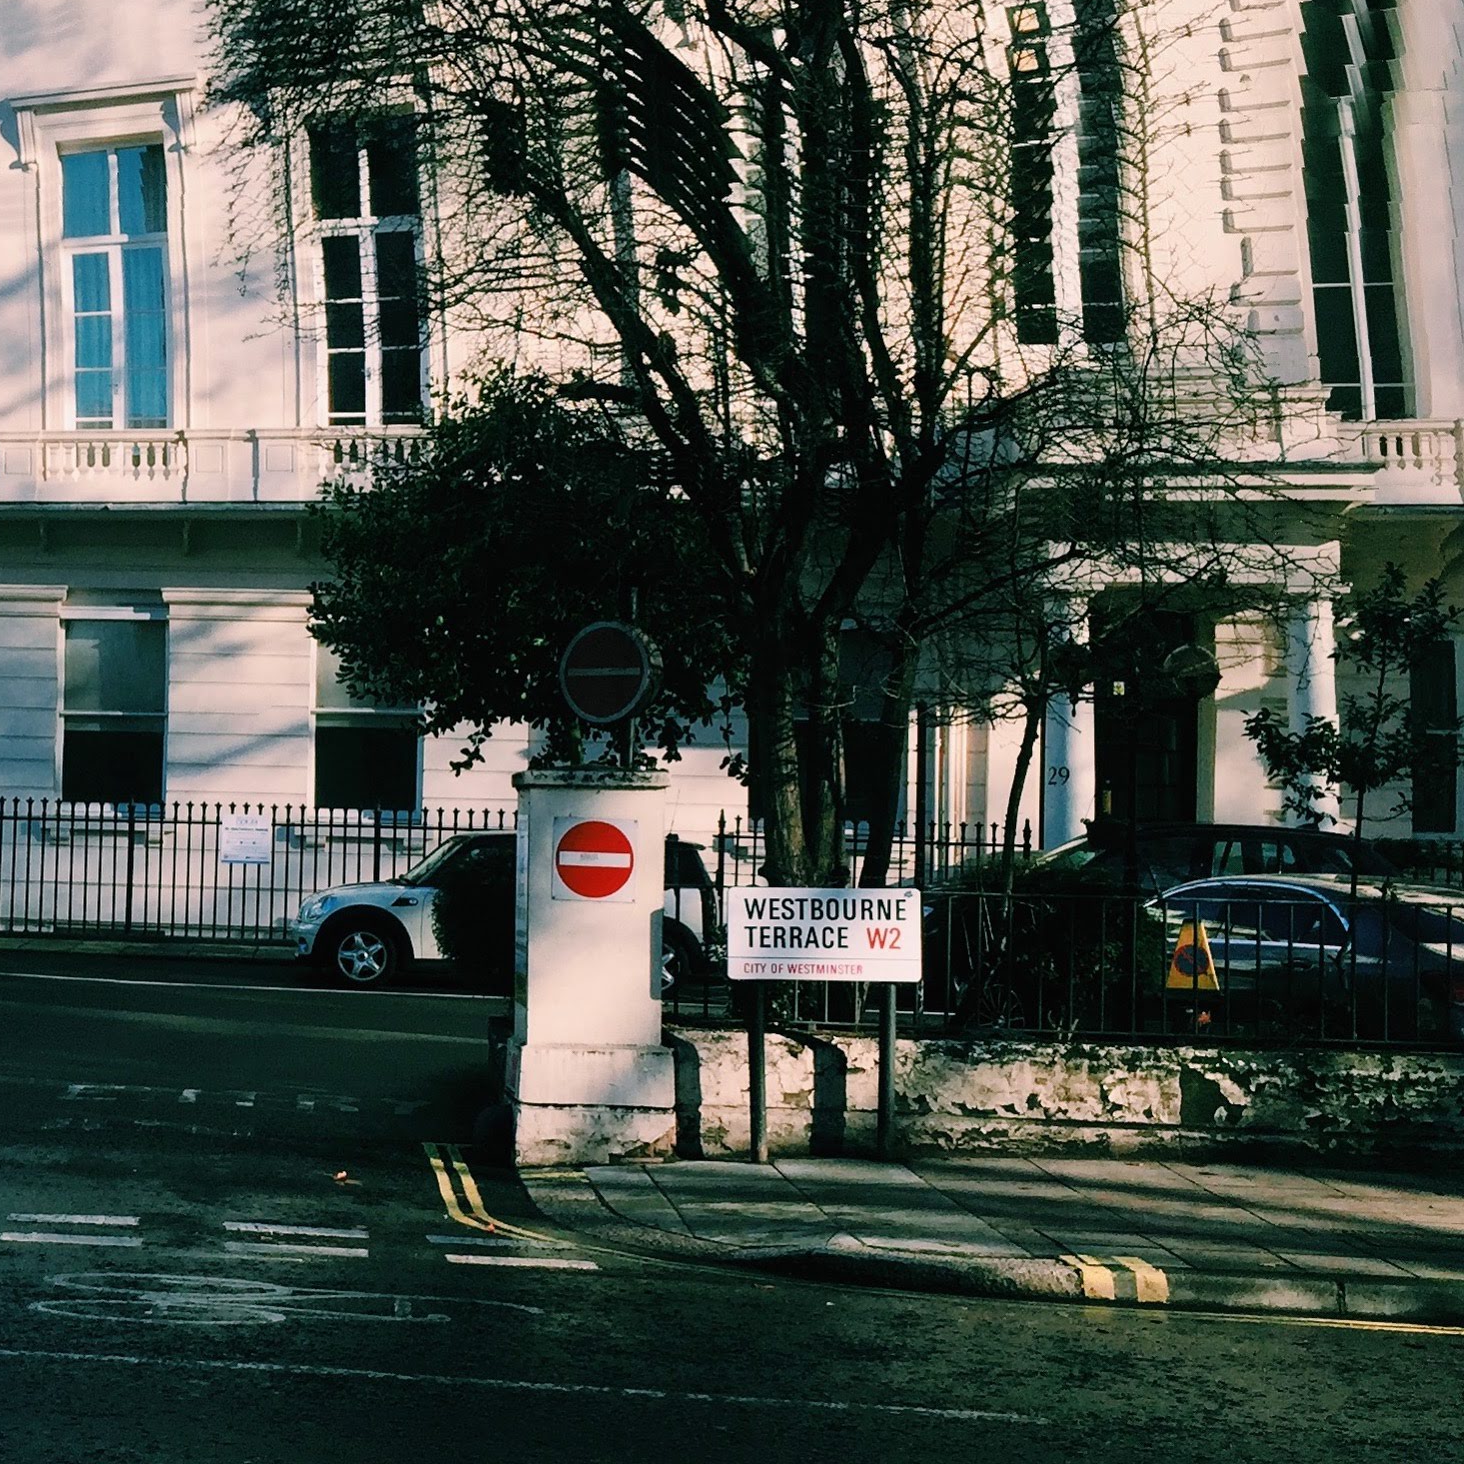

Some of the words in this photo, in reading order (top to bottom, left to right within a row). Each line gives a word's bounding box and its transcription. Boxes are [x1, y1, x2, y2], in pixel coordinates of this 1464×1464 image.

[1047, 766, 1070, 786] 29
[744, 898, 907, 921] WESTBOURNE
[744, 926, 849, 949] TERRACE
[866, 927, 901, 950] W2
[743, 962, 767, 974] CITY
[770, 962, 784, 974] OF
[787, 963, 863, 975] WESTMINSTER
